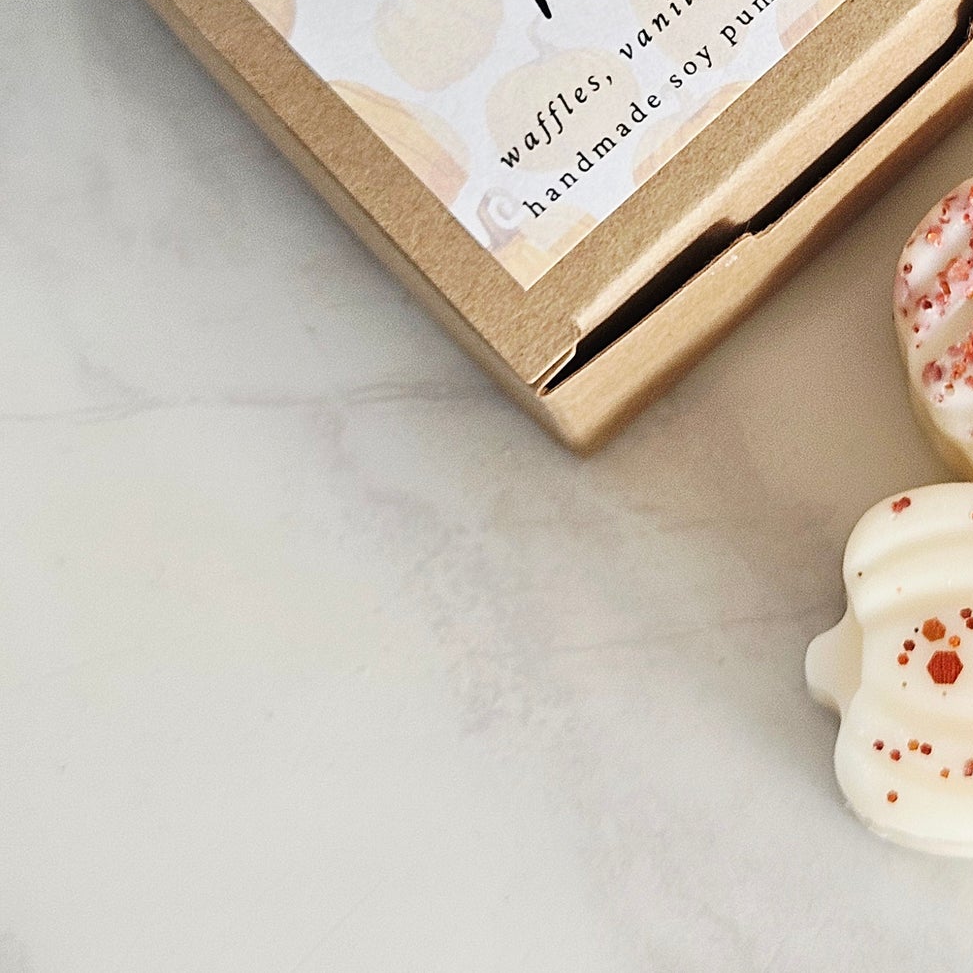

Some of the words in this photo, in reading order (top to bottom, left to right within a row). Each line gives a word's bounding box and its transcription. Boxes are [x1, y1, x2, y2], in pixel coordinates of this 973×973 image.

[500, 74, 613, 168] waffles,
[522, 94, 662, 218] handmade
[669, 45, 713, 88] soy
